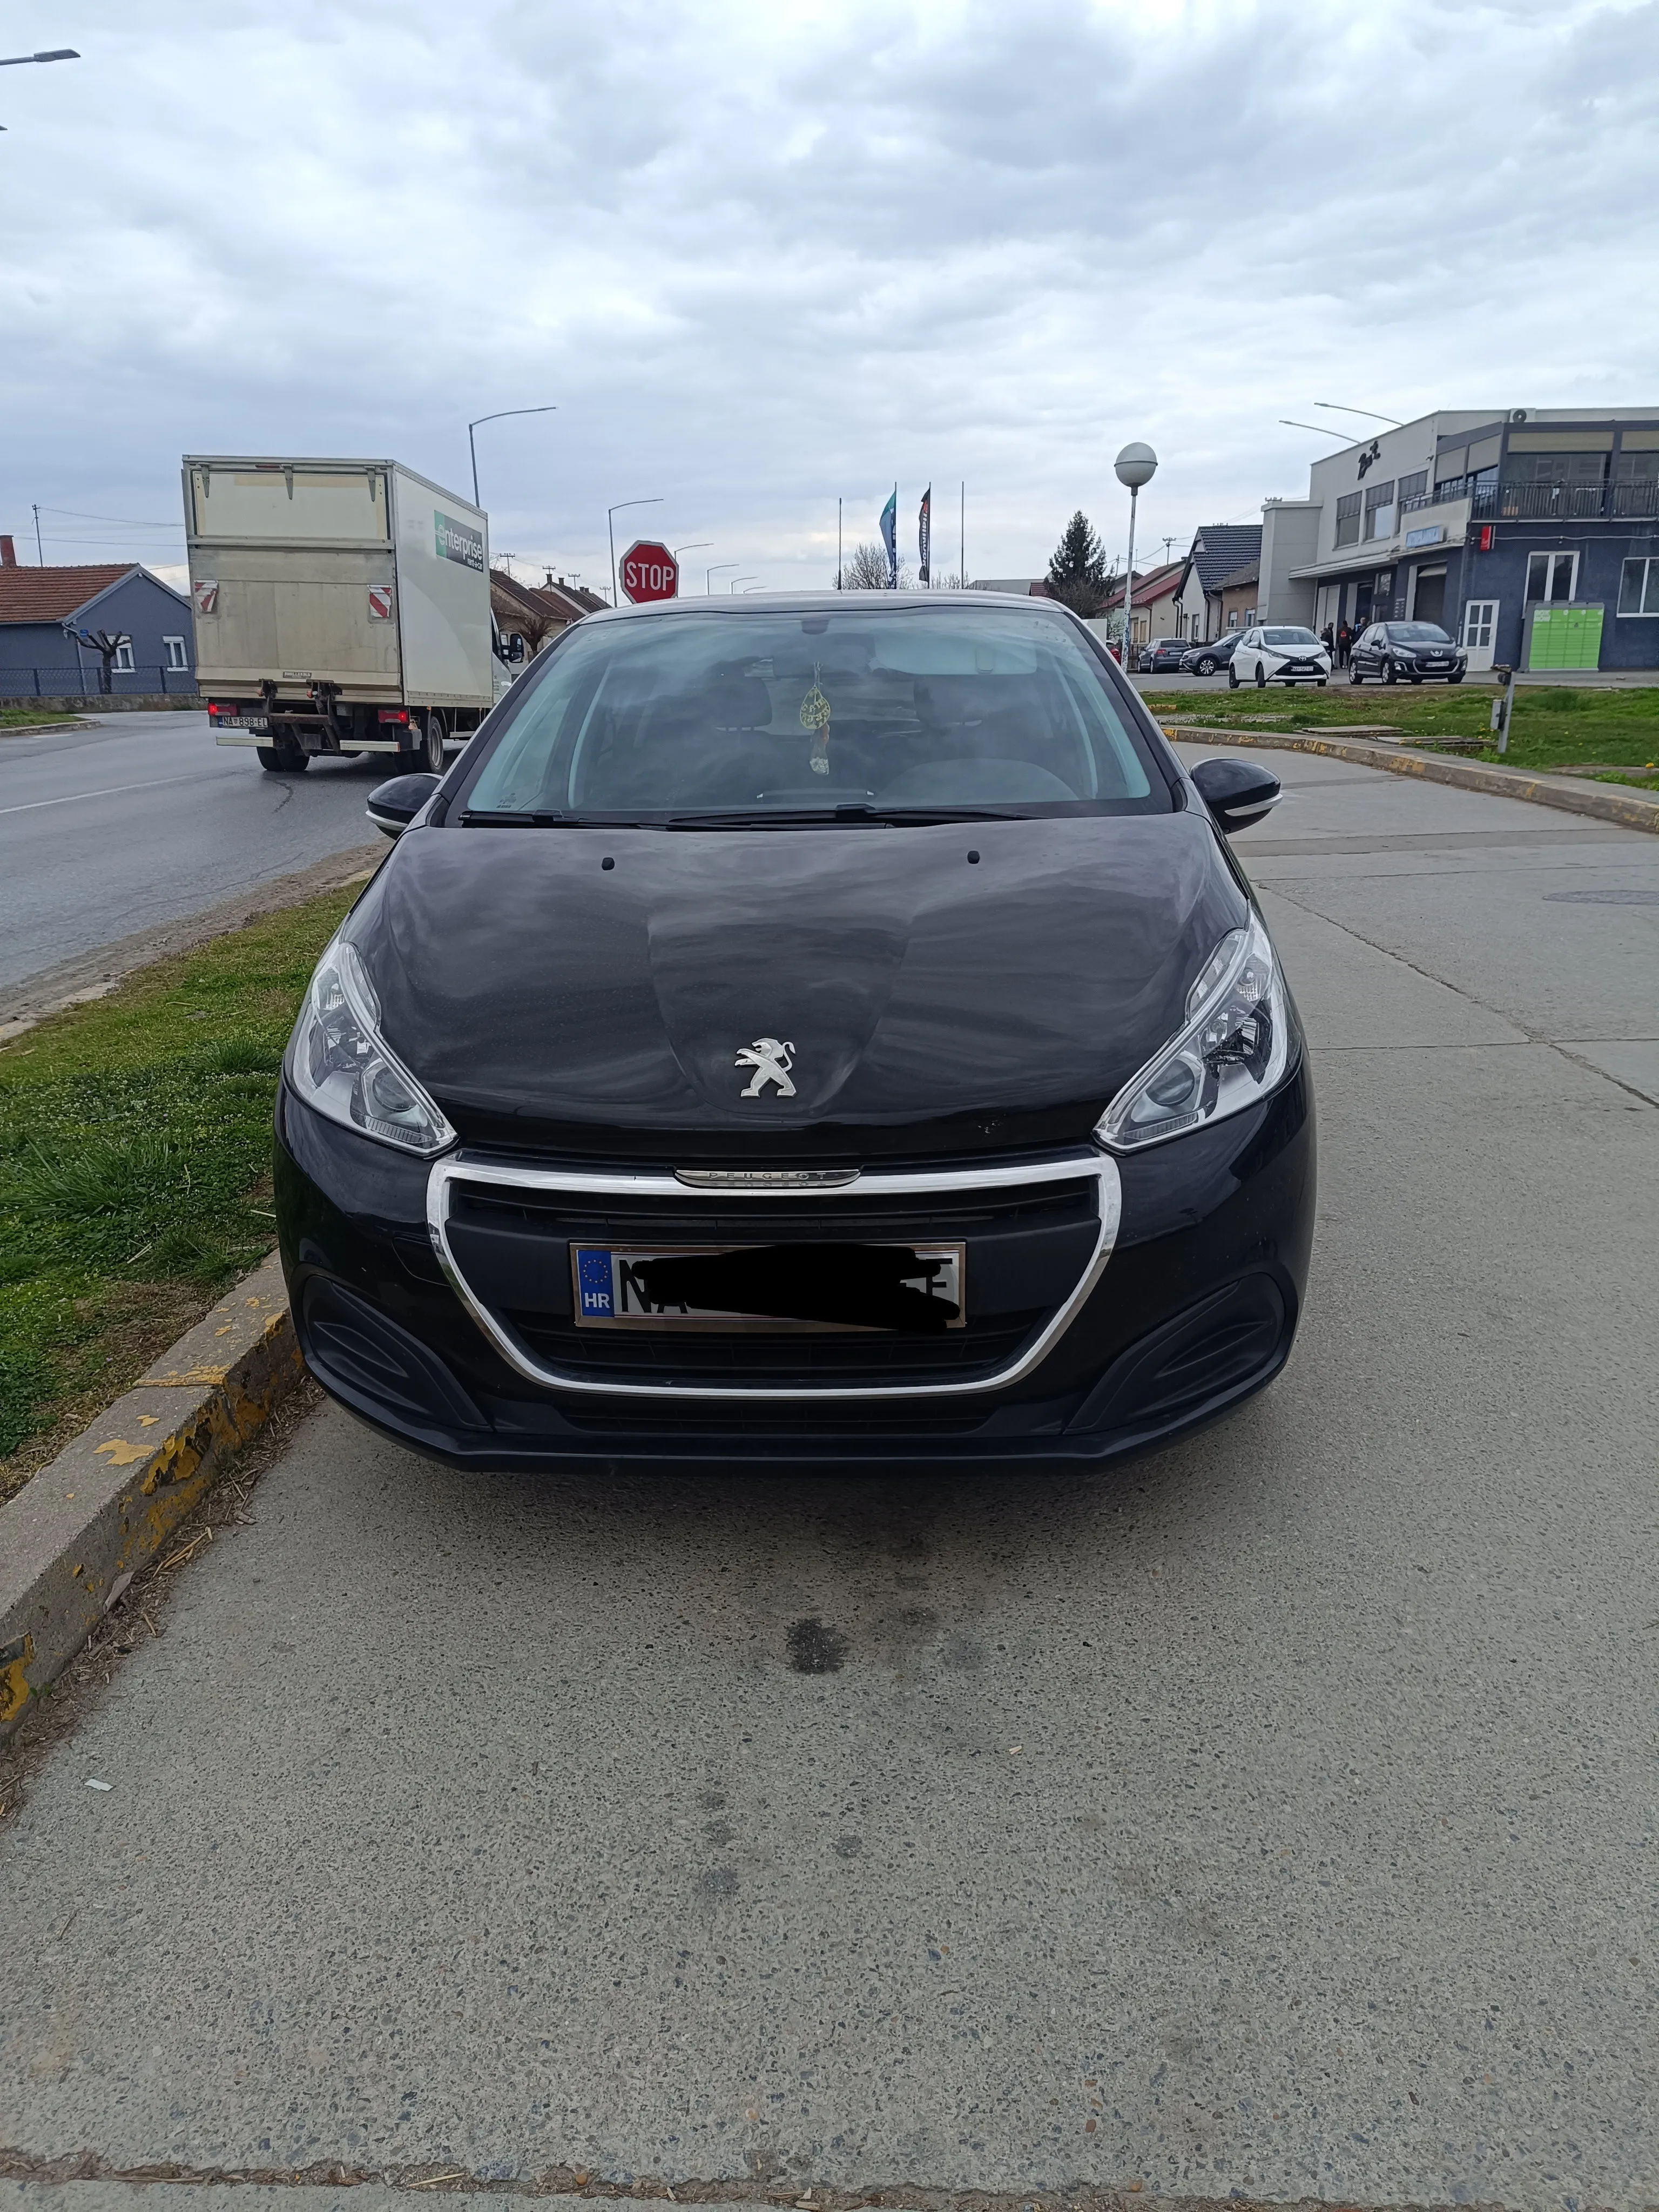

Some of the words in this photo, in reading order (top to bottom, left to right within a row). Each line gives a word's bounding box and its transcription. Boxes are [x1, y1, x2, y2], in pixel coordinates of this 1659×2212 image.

[435, 524, 482, 560] enterprise
[626, 562, 674, 591] STOP
[224, 716, 233, 725] NA
[584, 1292, 610, 1309] HR
